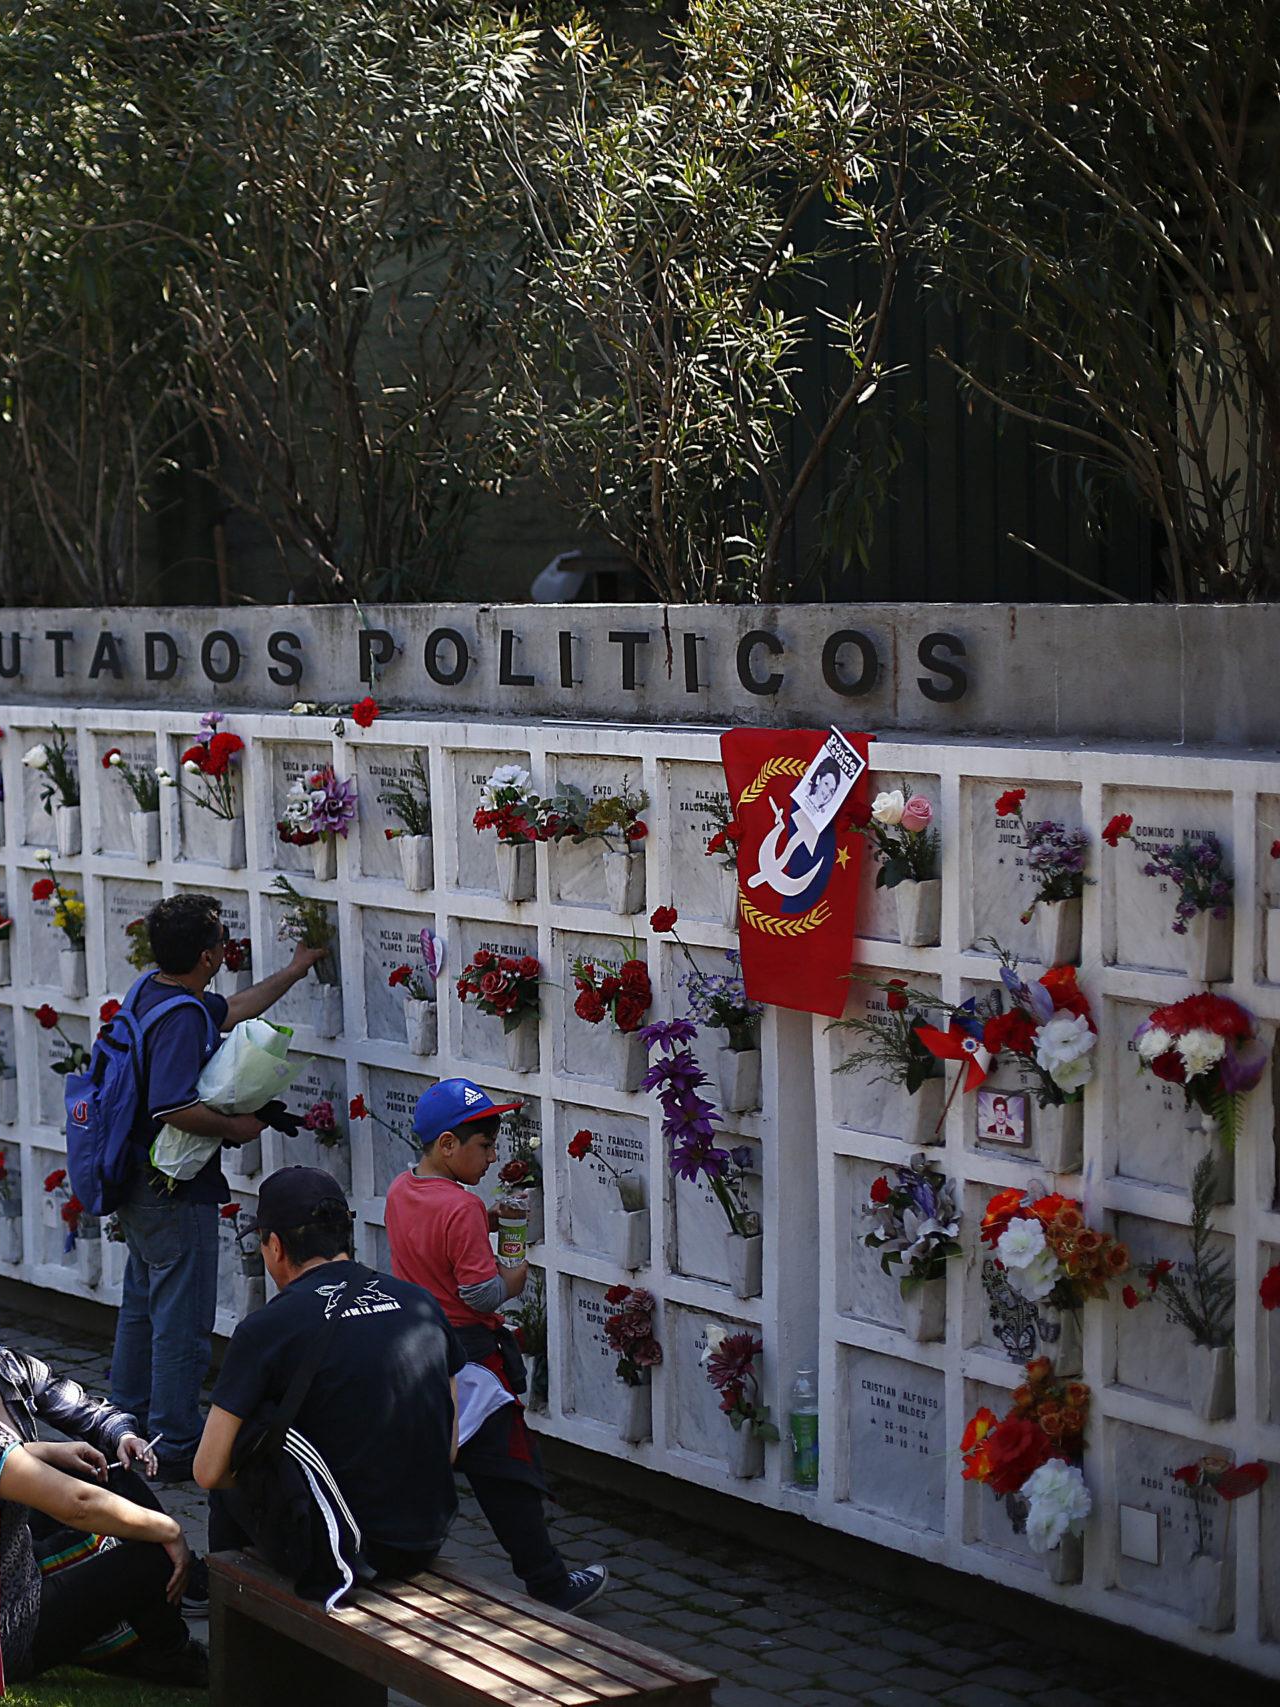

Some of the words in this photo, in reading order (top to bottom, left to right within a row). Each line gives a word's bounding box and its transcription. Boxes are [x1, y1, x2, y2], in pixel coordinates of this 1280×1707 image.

[358, 627, 968, 704] POLITICOS
[593, 785, 611, 795] ENZO
[995, 818, 1019, 830] ERICK
[1136, 825, 1175, 838] DOMINGO
[998, 834, 1022, 845] JUICA
[478, 941, 499, 953] JORGE
[608, 1135, 643, 1150] FRANCISCO
[578, 1299, 600, 1312] OSCAR
[861, 1379, 896, 1398] CRISTIAN
[902, 1391, 938, 1409] ALFONSO
[870, 1395, 891, 1410] LARA
[897, 1403, 926, 1420] VALDES
